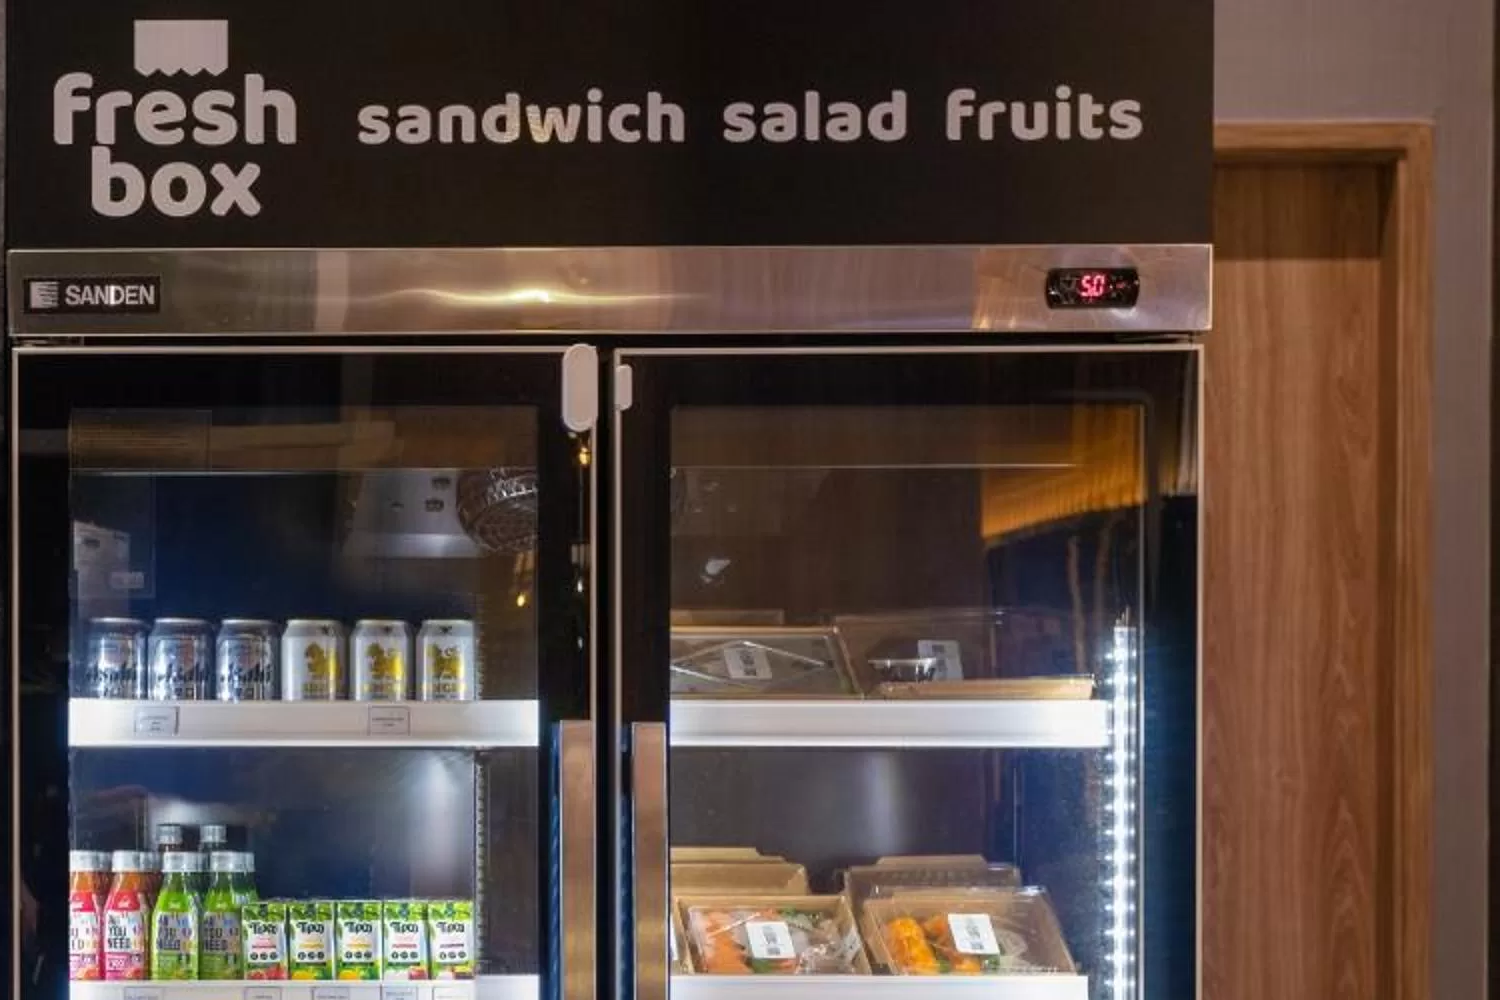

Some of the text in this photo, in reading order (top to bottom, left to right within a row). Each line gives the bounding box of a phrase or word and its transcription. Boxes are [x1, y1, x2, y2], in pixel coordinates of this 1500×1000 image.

[53, 73, 296, 145] fresh
[358, 85, 1143, 144] sandwich salad fruits
[91, 146, 261, 217] box
[65, 284, 155, 305] SANDEN
